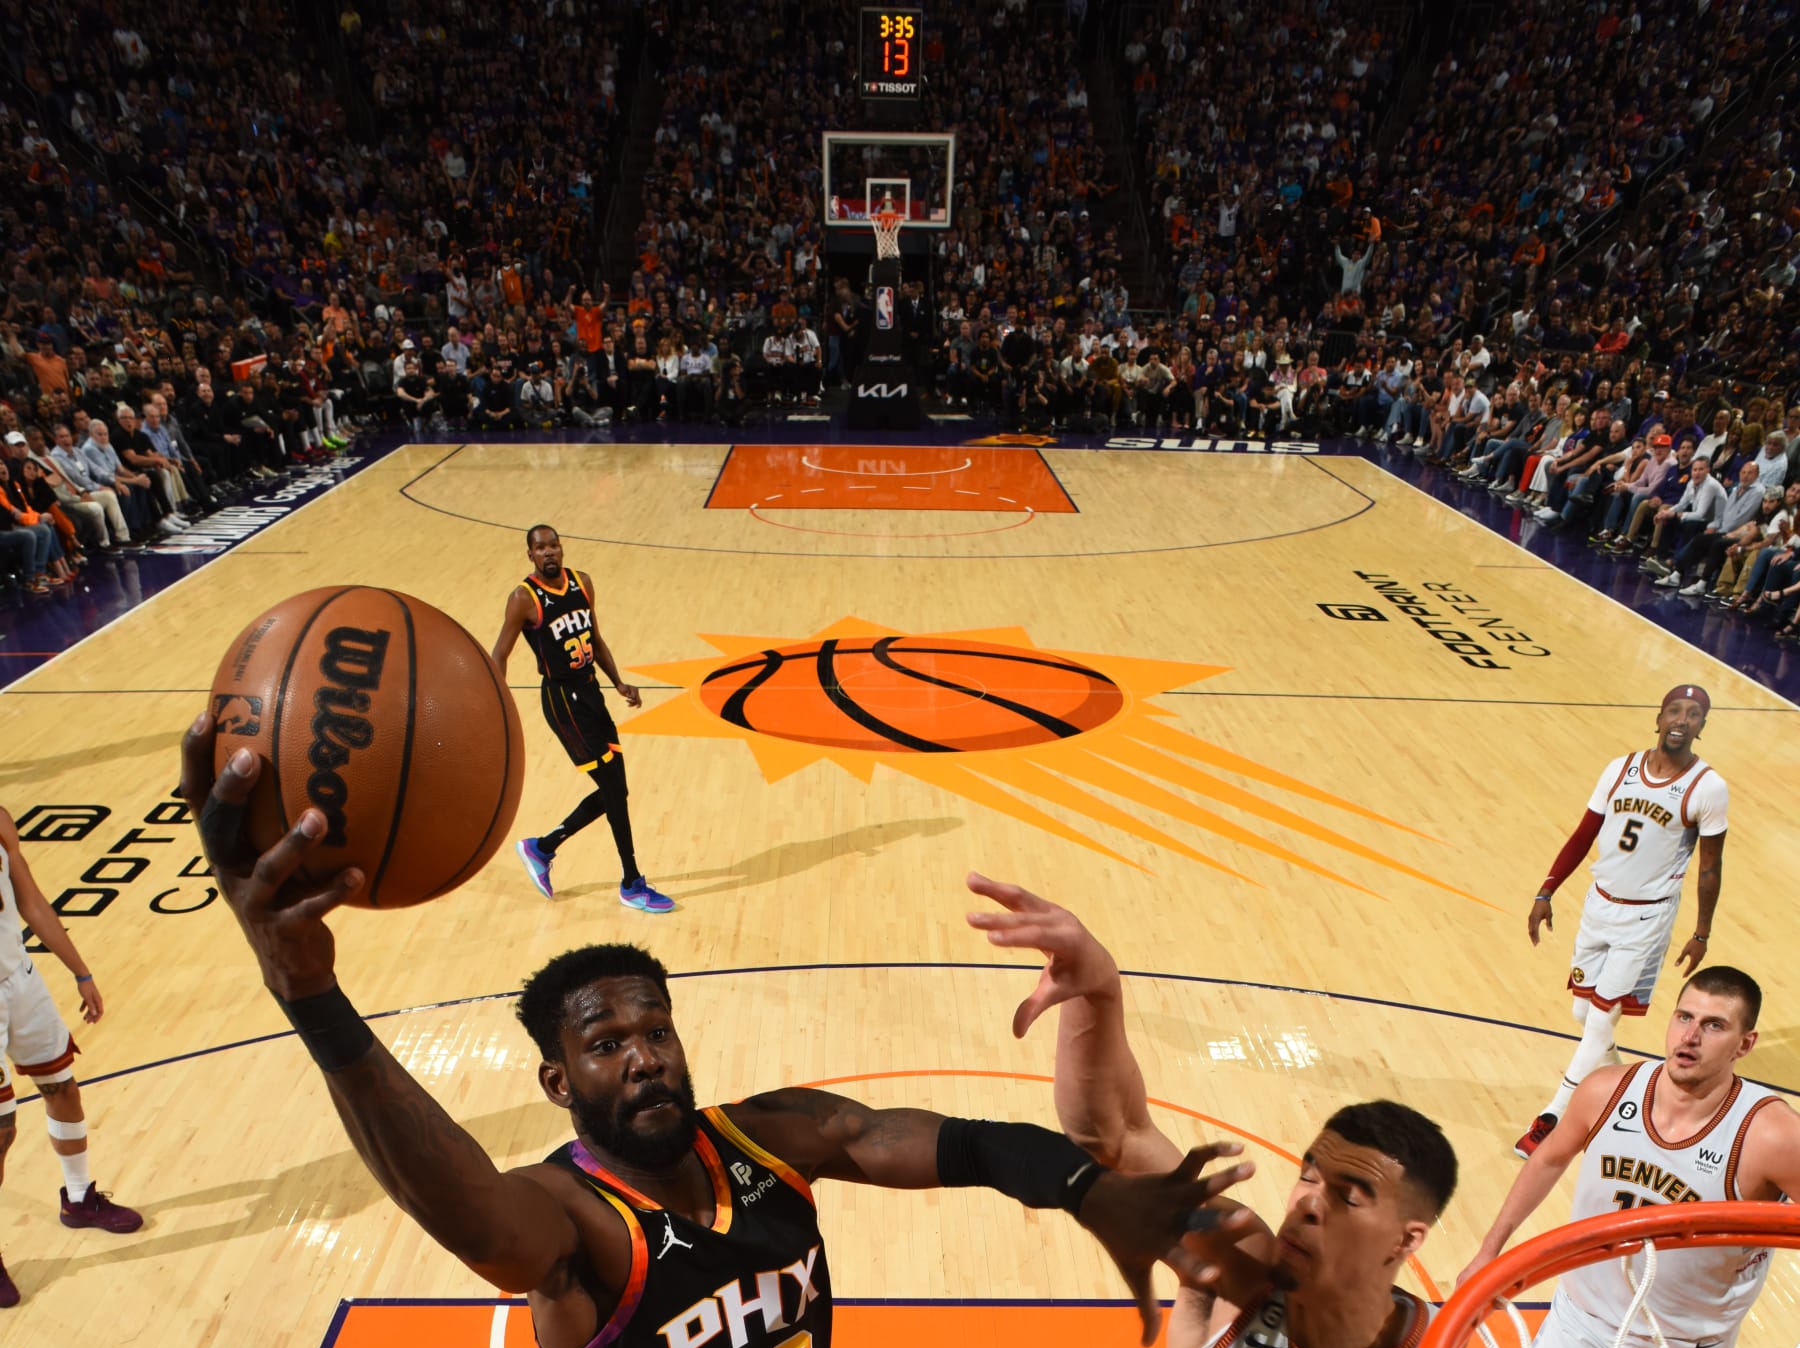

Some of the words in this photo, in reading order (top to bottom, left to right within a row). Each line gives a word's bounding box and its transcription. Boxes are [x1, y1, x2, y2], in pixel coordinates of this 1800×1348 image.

[880, 15, 914, 38] 3:35
[884, 39, 909, 75] 13
[879, 82, 917, 93] TISSOT
[858, 383, 907, 398] KIA
[549, 608, 593, 641] PHX
[1352, 570, 1512, 669] FOOTPRINT
[1421, 582, 1552, 657] CENTER
[564, 630, 594, 670] 35
[306, 625, 391, 849] Wilson
[1613, 797, 1674, 828] DENVER
[1618, 818, 1645, 853] 5
[1621, 1104, 1635, 1119] 6
[1699, 1147, 1724, 1165] WU
[740, 1173, 777, 1207] PayPal
